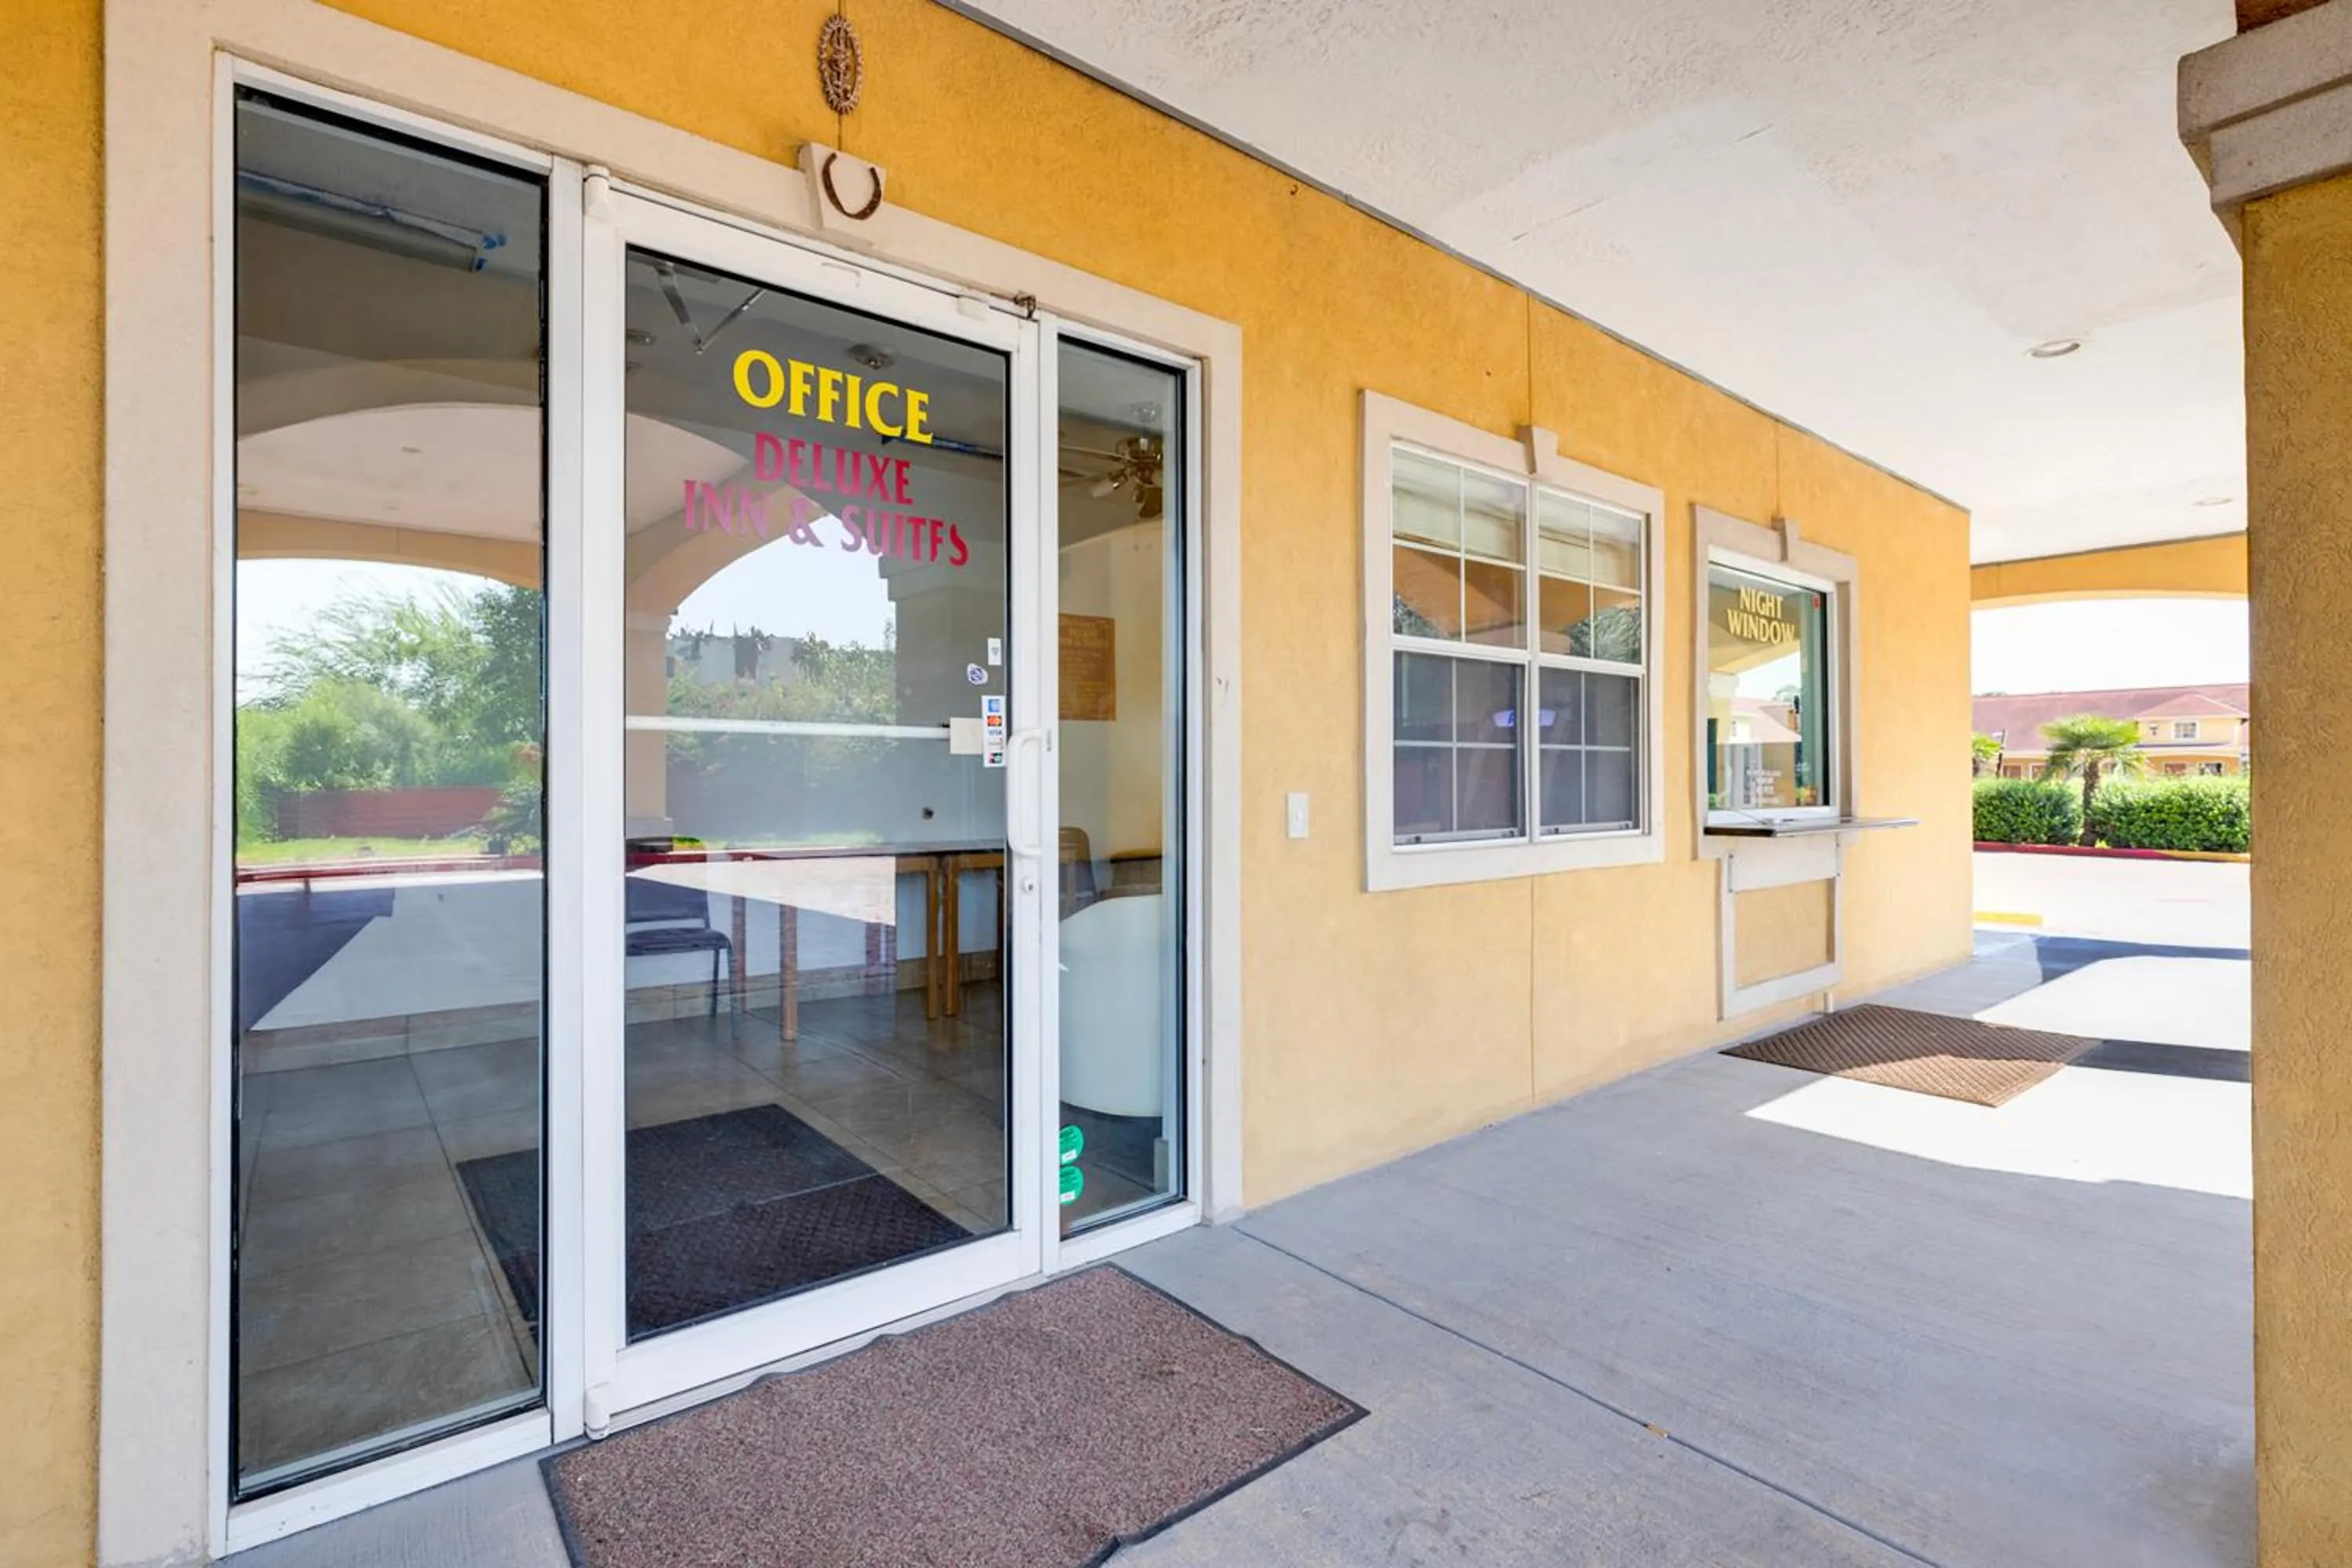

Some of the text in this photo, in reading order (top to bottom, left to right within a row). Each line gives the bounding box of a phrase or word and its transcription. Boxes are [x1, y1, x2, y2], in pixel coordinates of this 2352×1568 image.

[733, 350, 934, 445] OFFICE
[754, 431, 914, 506] DELUXE
[684, 479, 771, 539] INN
[788, 497, 824, 547] &
[1727, 608, 1795, 644] WINDOW
[1740, 586, 1784, 619] NIGHT
